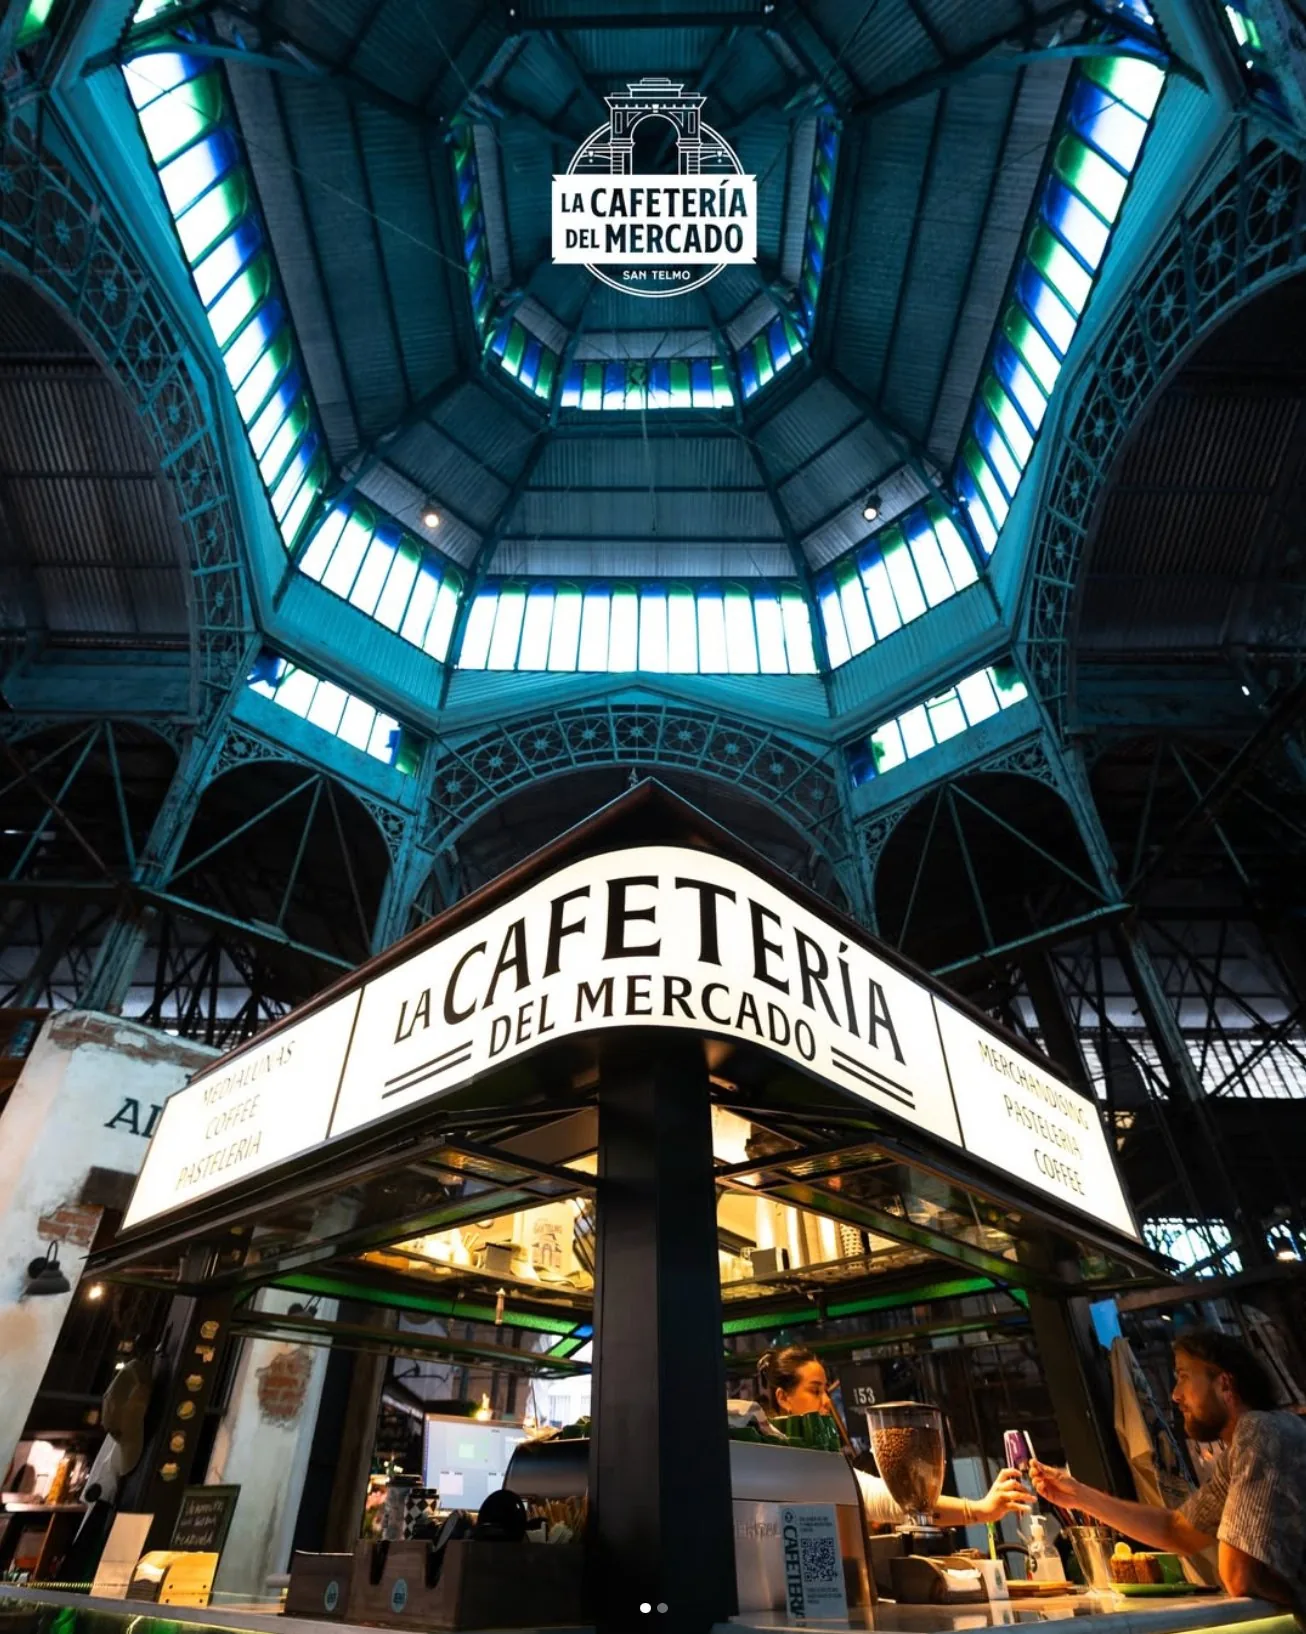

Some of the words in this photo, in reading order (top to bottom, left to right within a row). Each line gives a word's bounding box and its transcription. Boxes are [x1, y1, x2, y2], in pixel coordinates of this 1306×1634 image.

[394, 988, 431, 1044] LA
[442, 874, 907, 1066] CAFETERÍA
[487, 993, 556, 1059] DEL
[573, 974, 817, 1062] MERCADO
[205, 1093, 261, 1140] COFFEE
[1033, 1147, 1086, 1196] COFFEE
[853, 1386, 876, 1405] 153
